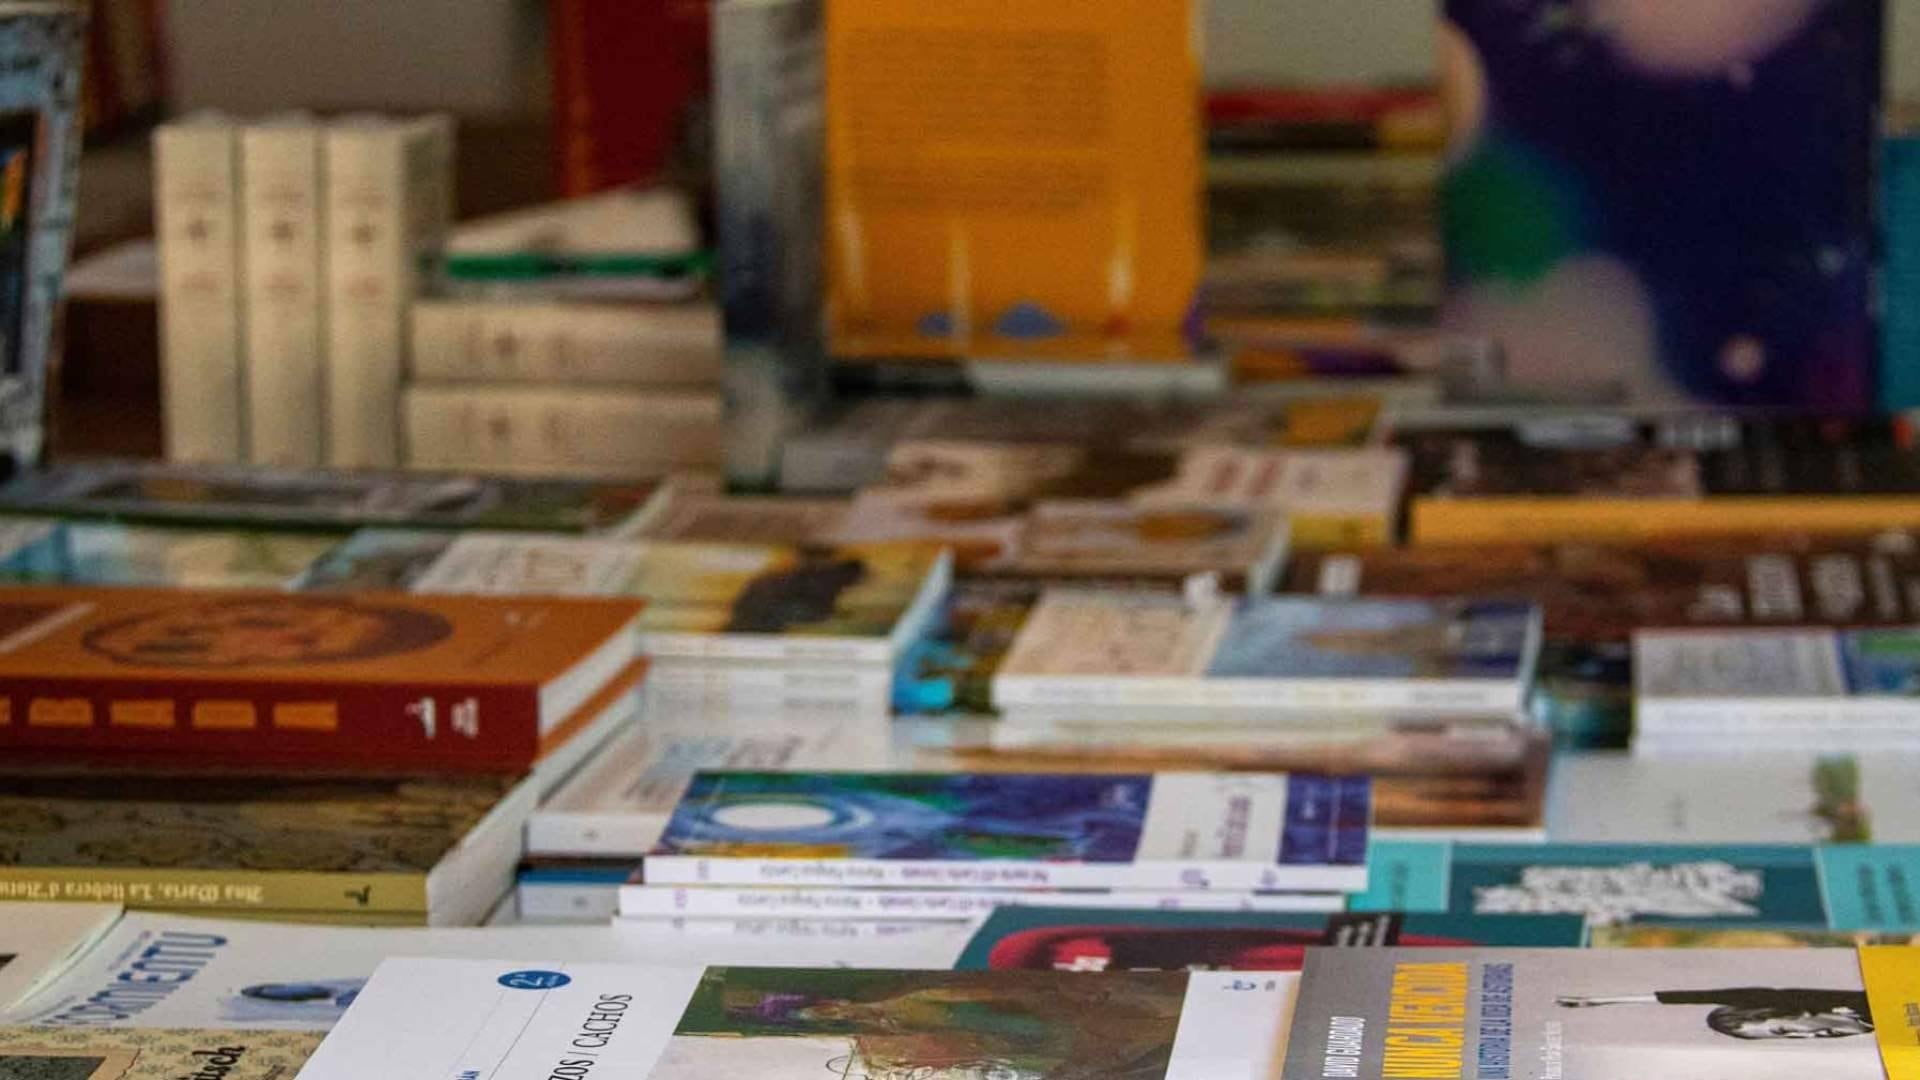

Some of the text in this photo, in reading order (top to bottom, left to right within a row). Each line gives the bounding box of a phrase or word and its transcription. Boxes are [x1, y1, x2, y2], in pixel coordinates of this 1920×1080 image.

[572, 993, 633, 1048] CACHOS
[1322, 1016, 1367, 1078] DAVID GUARDADO
[1382, 1027, 1464, 1078] NUNCA
